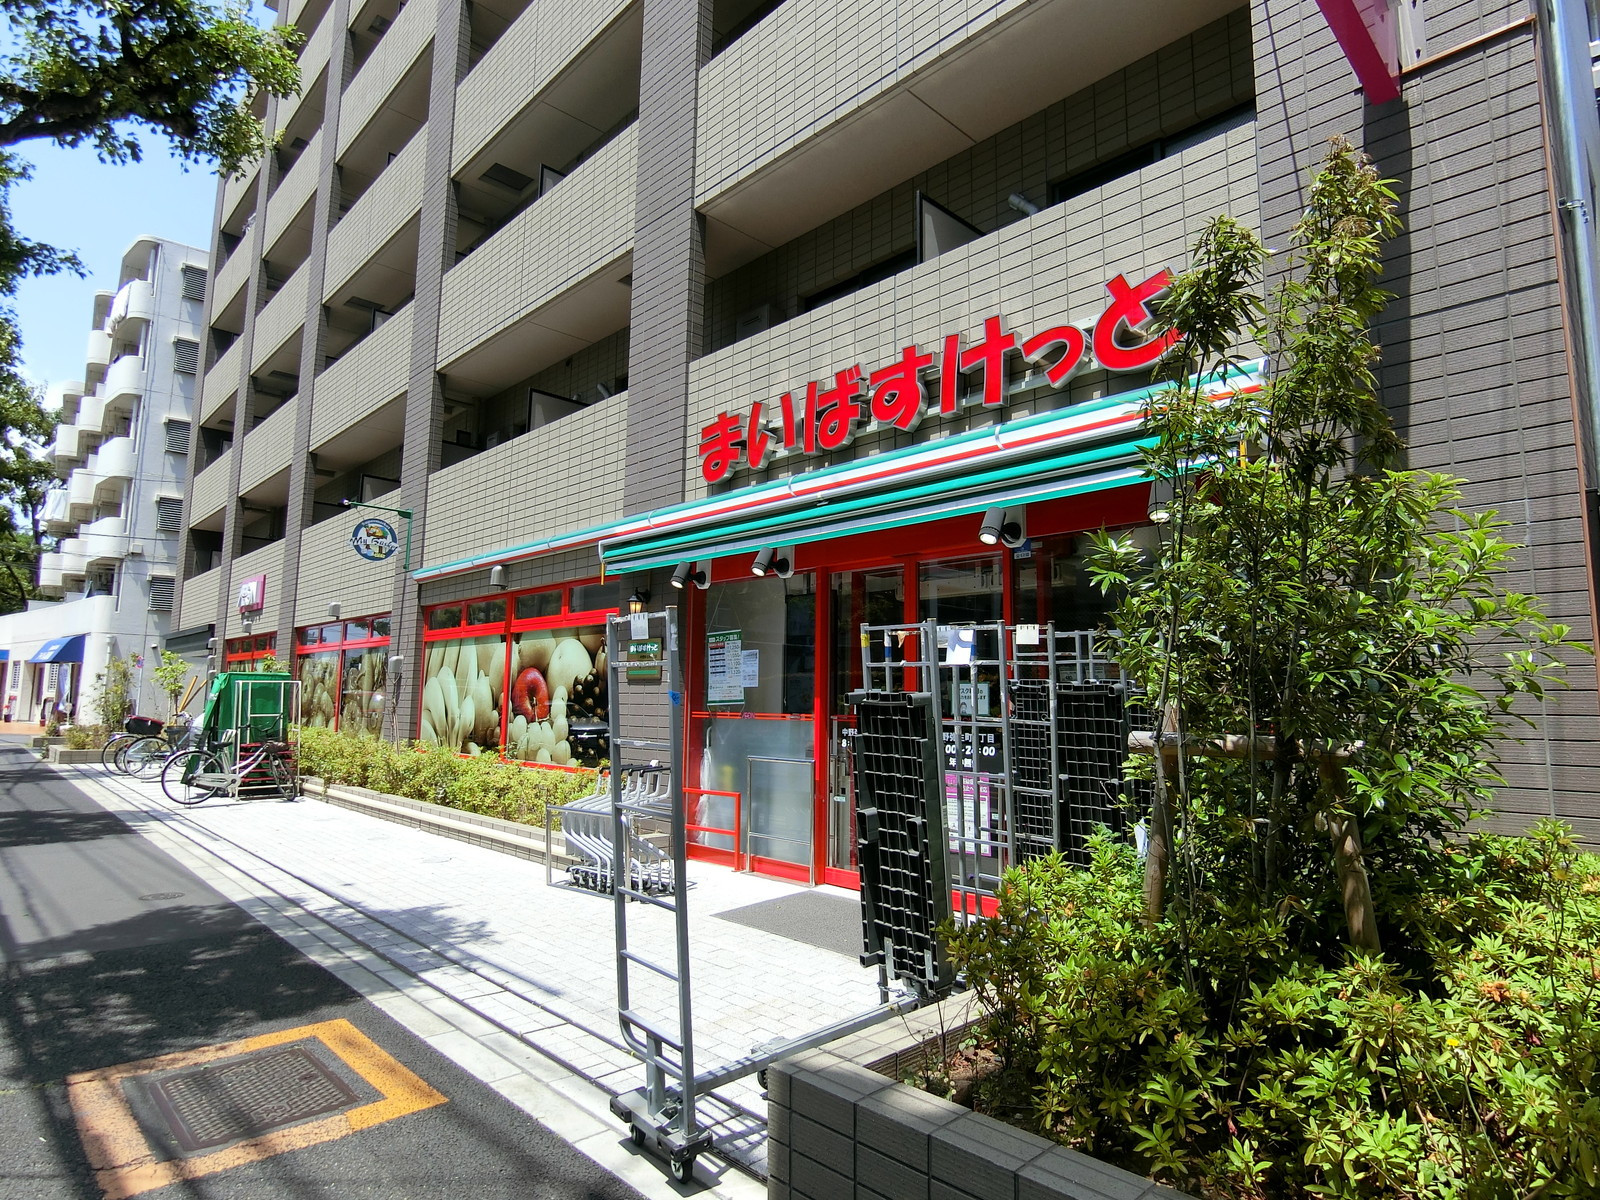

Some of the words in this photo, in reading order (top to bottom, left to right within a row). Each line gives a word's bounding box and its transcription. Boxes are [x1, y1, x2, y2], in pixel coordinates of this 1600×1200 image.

[699, 266, 1187, 484] まいばすけっと
